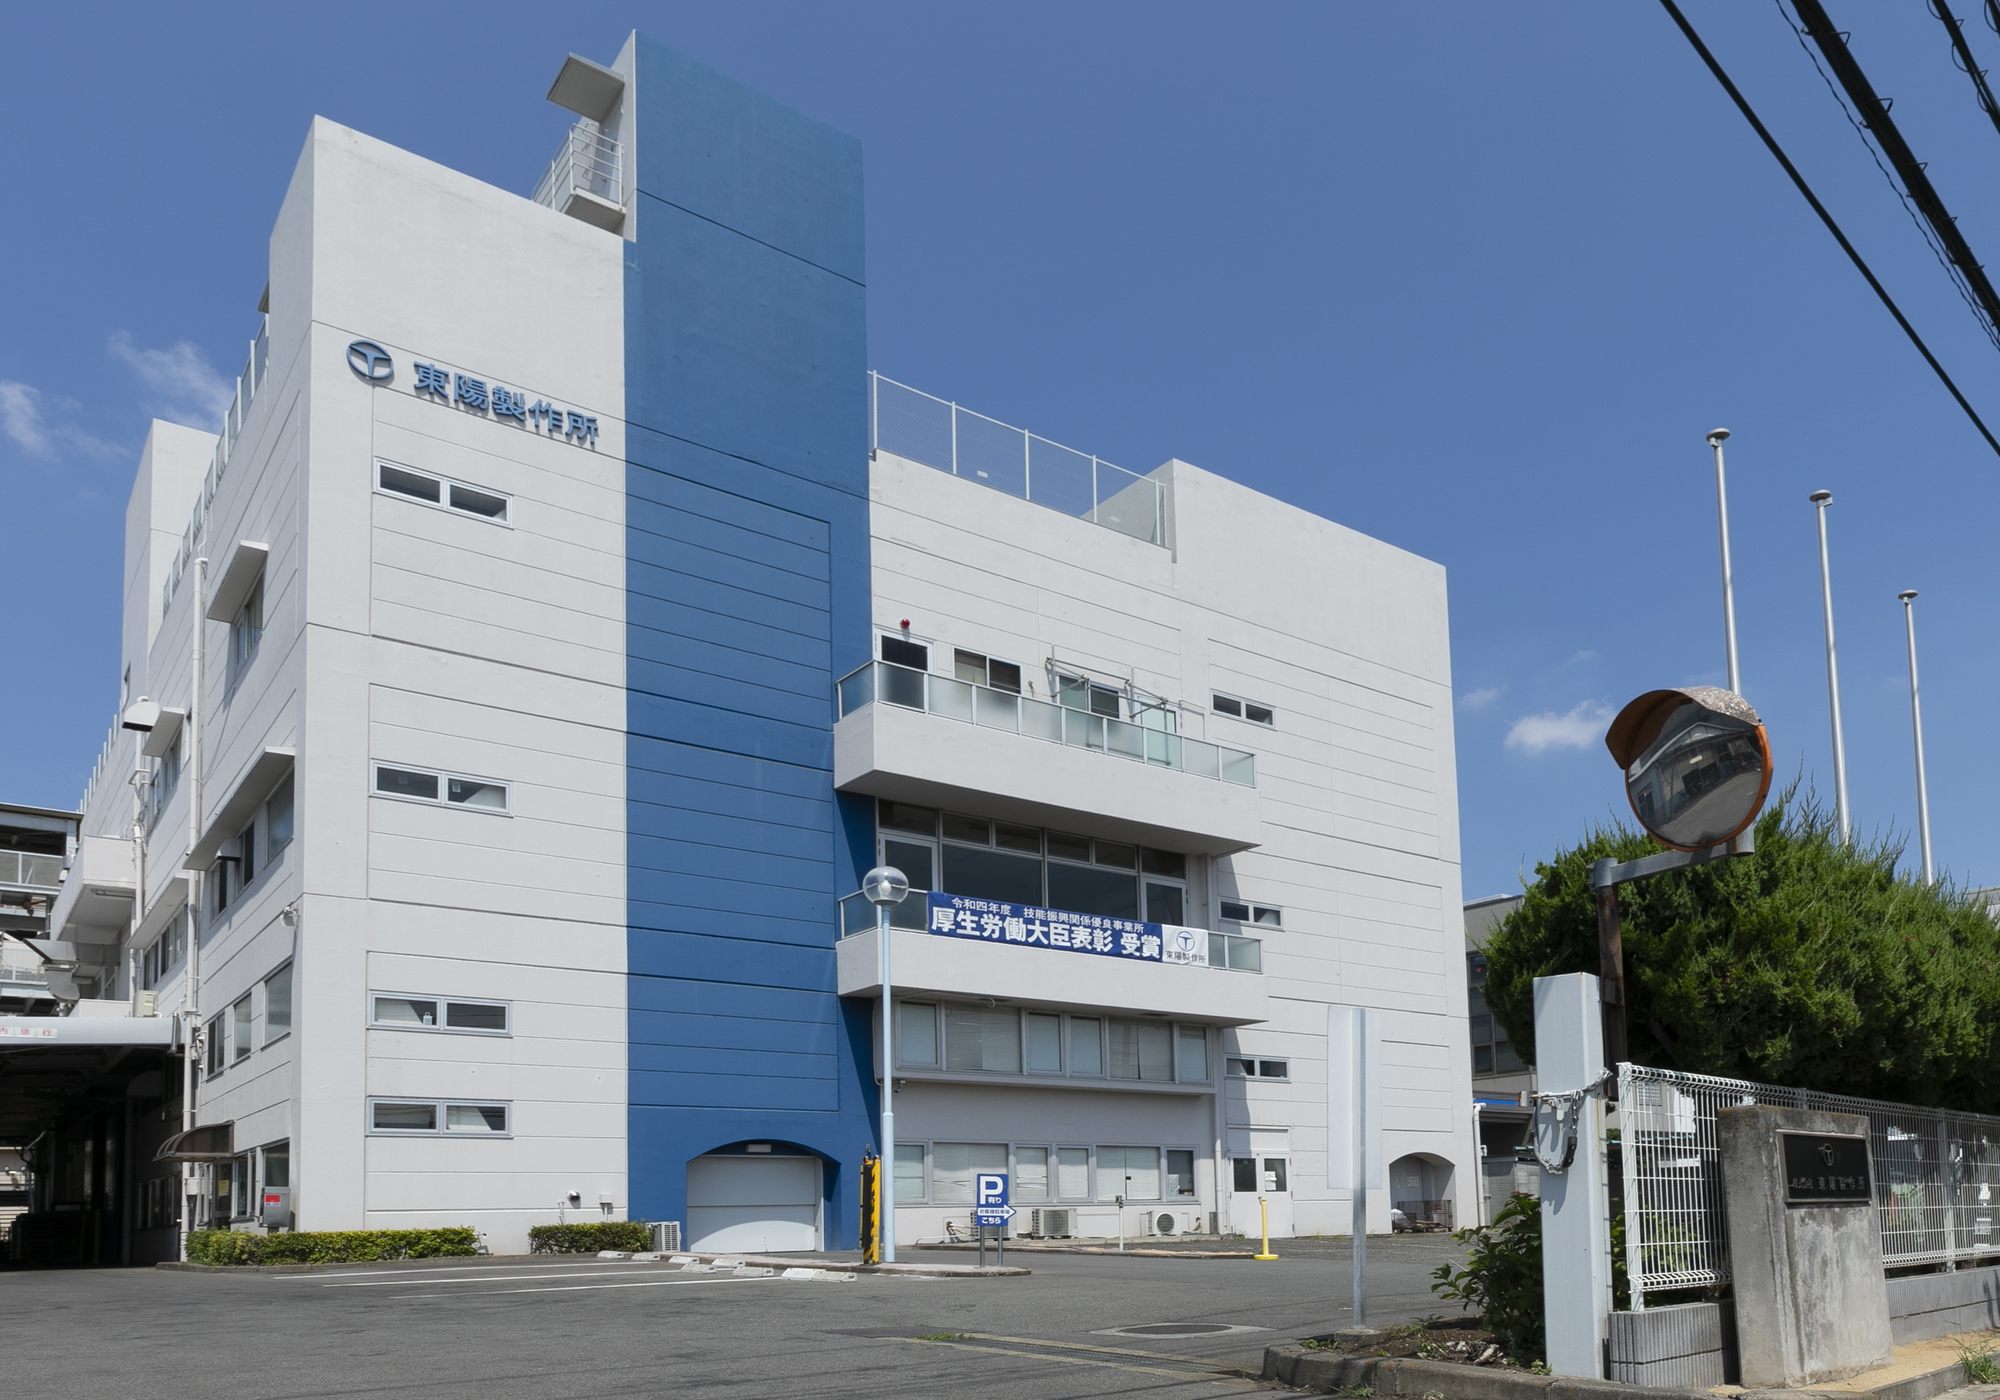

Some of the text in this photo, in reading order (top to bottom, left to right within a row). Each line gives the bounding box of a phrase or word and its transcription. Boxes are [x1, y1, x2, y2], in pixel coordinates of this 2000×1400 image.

[413, 361, 599, 446] 東陽製作所
[931, 906, 1161, 959] 厚生労働大臣表彰 受賞
[952, 897, 1144, 934] 令和四年度 技能振興関係優良事業所
[980, 1175, 1004, 1205] P
